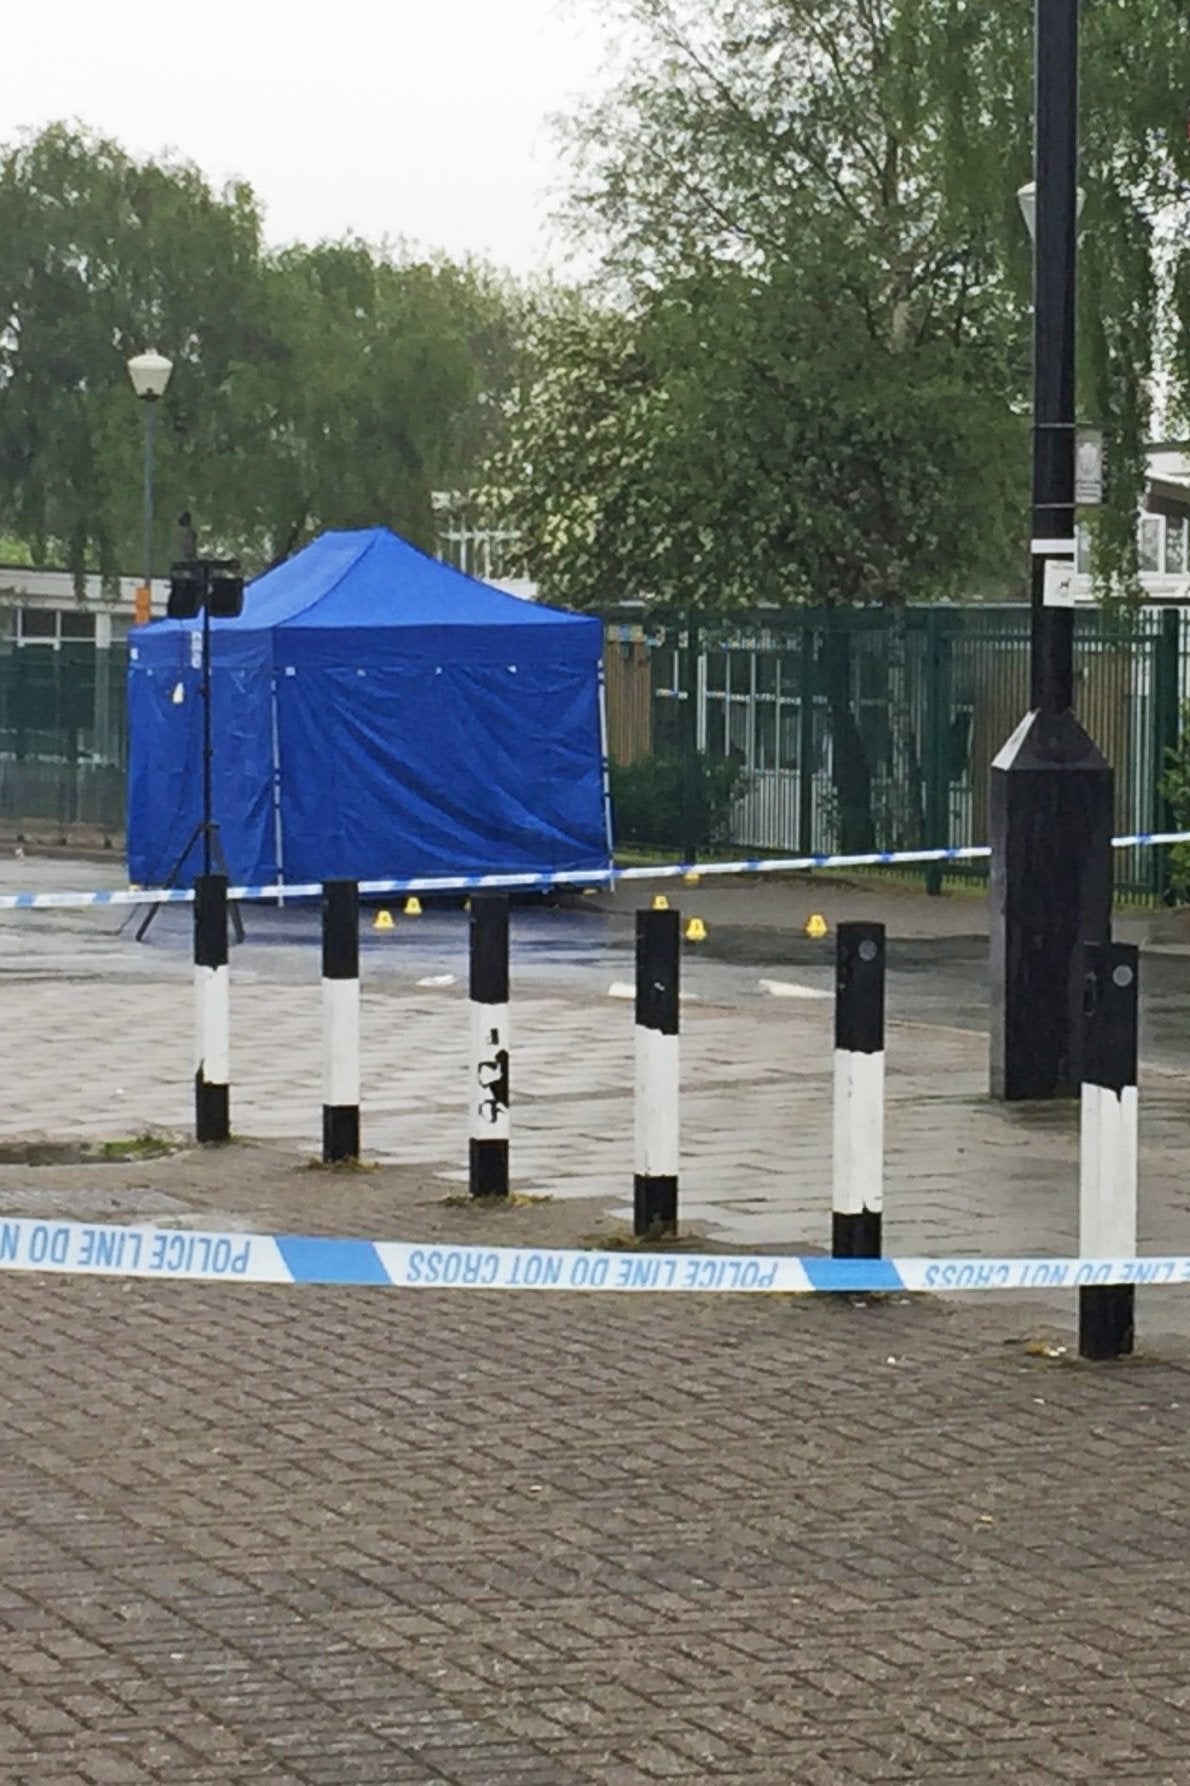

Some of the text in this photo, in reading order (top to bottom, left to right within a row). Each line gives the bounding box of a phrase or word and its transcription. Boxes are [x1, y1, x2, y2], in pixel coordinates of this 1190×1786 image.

[29, 1226, 70, 1264] DO
[78, 1230, 143, 1268] LINE
[149, 1234, 252, 1274] POLICE
[407, 1250, 778, 1288] POLICE LINE DO NOT CROSS
[1119, 1261, 1175, 1283] LINE
